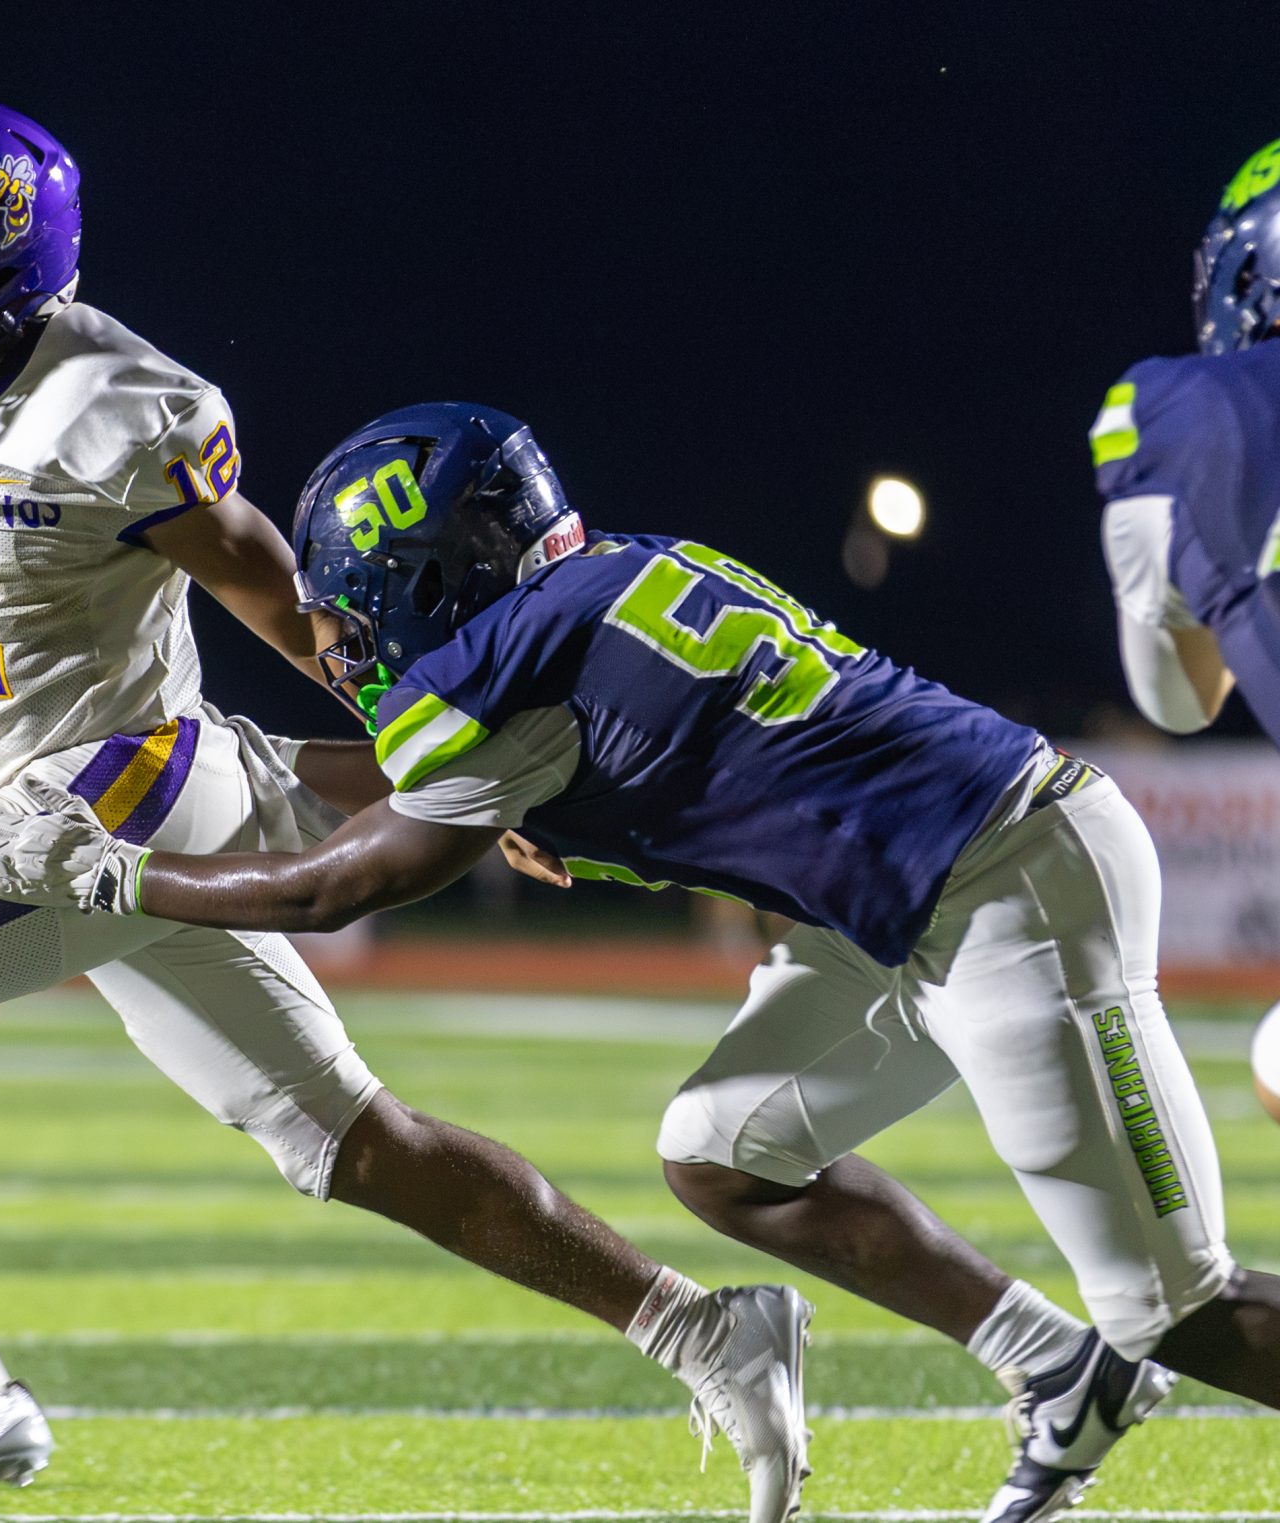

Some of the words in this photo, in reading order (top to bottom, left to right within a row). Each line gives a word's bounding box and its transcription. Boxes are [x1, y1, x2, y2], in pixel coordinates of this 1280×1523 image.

[163, 420, 239, 504] 12
[333, 458, 428, 552] 50
[602, 539, 869, 728] 50
[1091, 1005, 1189, 1219] HURRICANES
